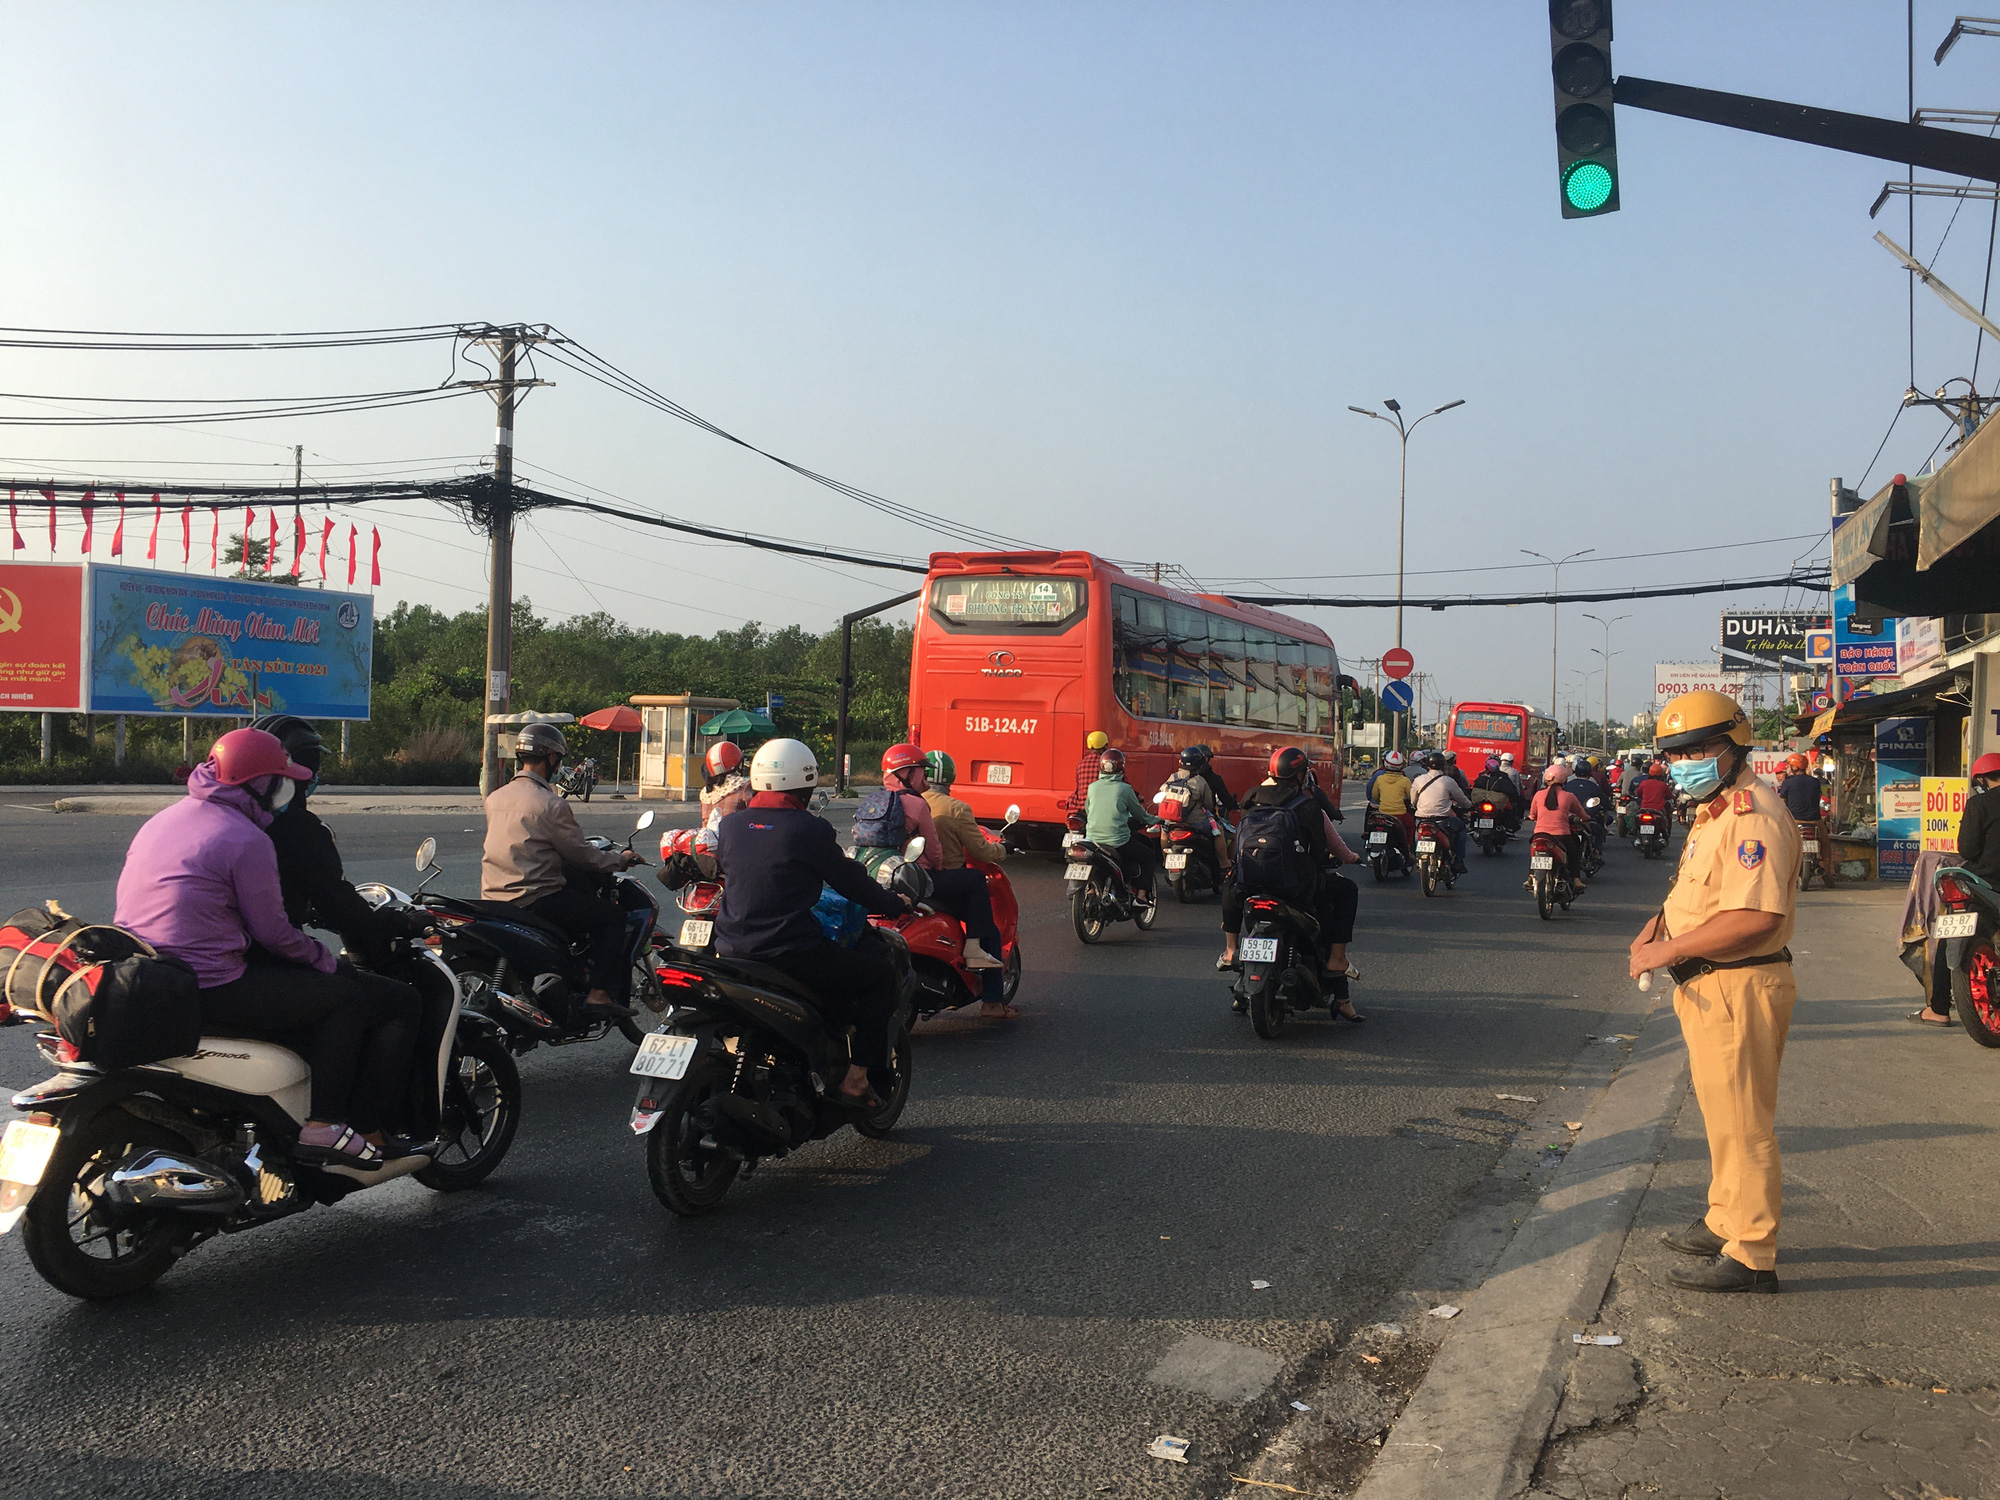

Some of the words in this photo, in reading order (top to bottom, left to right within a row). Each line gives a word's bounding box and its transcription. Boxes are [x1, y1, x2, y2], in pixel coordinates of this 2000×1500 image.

[1038, 585, 1049, 593] 14
[1011, 602, 1045, 614] TRANG
[146, 602, 189, 632] Chúc
[191, 607, 242, 643] Mừng
[245, 611, 286, 640] Năm
[288, 616, 320, 643] Mới
[1727, 619, 1804, 635] DUHAL
[1758, 639, 1775, 650] Hào
[1840, 646, 1862, 658] BẢO
[1864, 645, 1894, 659] HÀNH
[229, 657, 262, 671] TÂN
[264, 657, 294, 673] SỬU
[296, 664, 328, 675] 2021
[1838, 660, 1866, 673] TOÀN
[1868, 659, 1895, 672] QUỐC
[981, 668, 1023, 678] THACO
[1657, 683, 1689, 694] 0903
[11, 692, 34, 701] NHIỆM
[965, 716, 1038, 734] 51B-124.47
[1463, 719, 1488, 731] MINH
[1879, 742, 1926, 750] PINAC
[993, 767, 1006, 775] 51B
[1927, 781, 1948, 812] ĐỔI
[1926, 819, 1949, 831] 100K
[1926, 838, 1939, 851] THU
[1940, 838, 1954, 851] MUA
[1880, 850, 1903, 864] ANH
[1942, 914, 1971, 926] 63-B7
[1247, 939, 1273, 950] 59-D2
[1242, 950, 1274, 961] 935.41
[648, 1038, 688, 1058] 62-L1
[636, 1055, 685, 1077] 807.71
